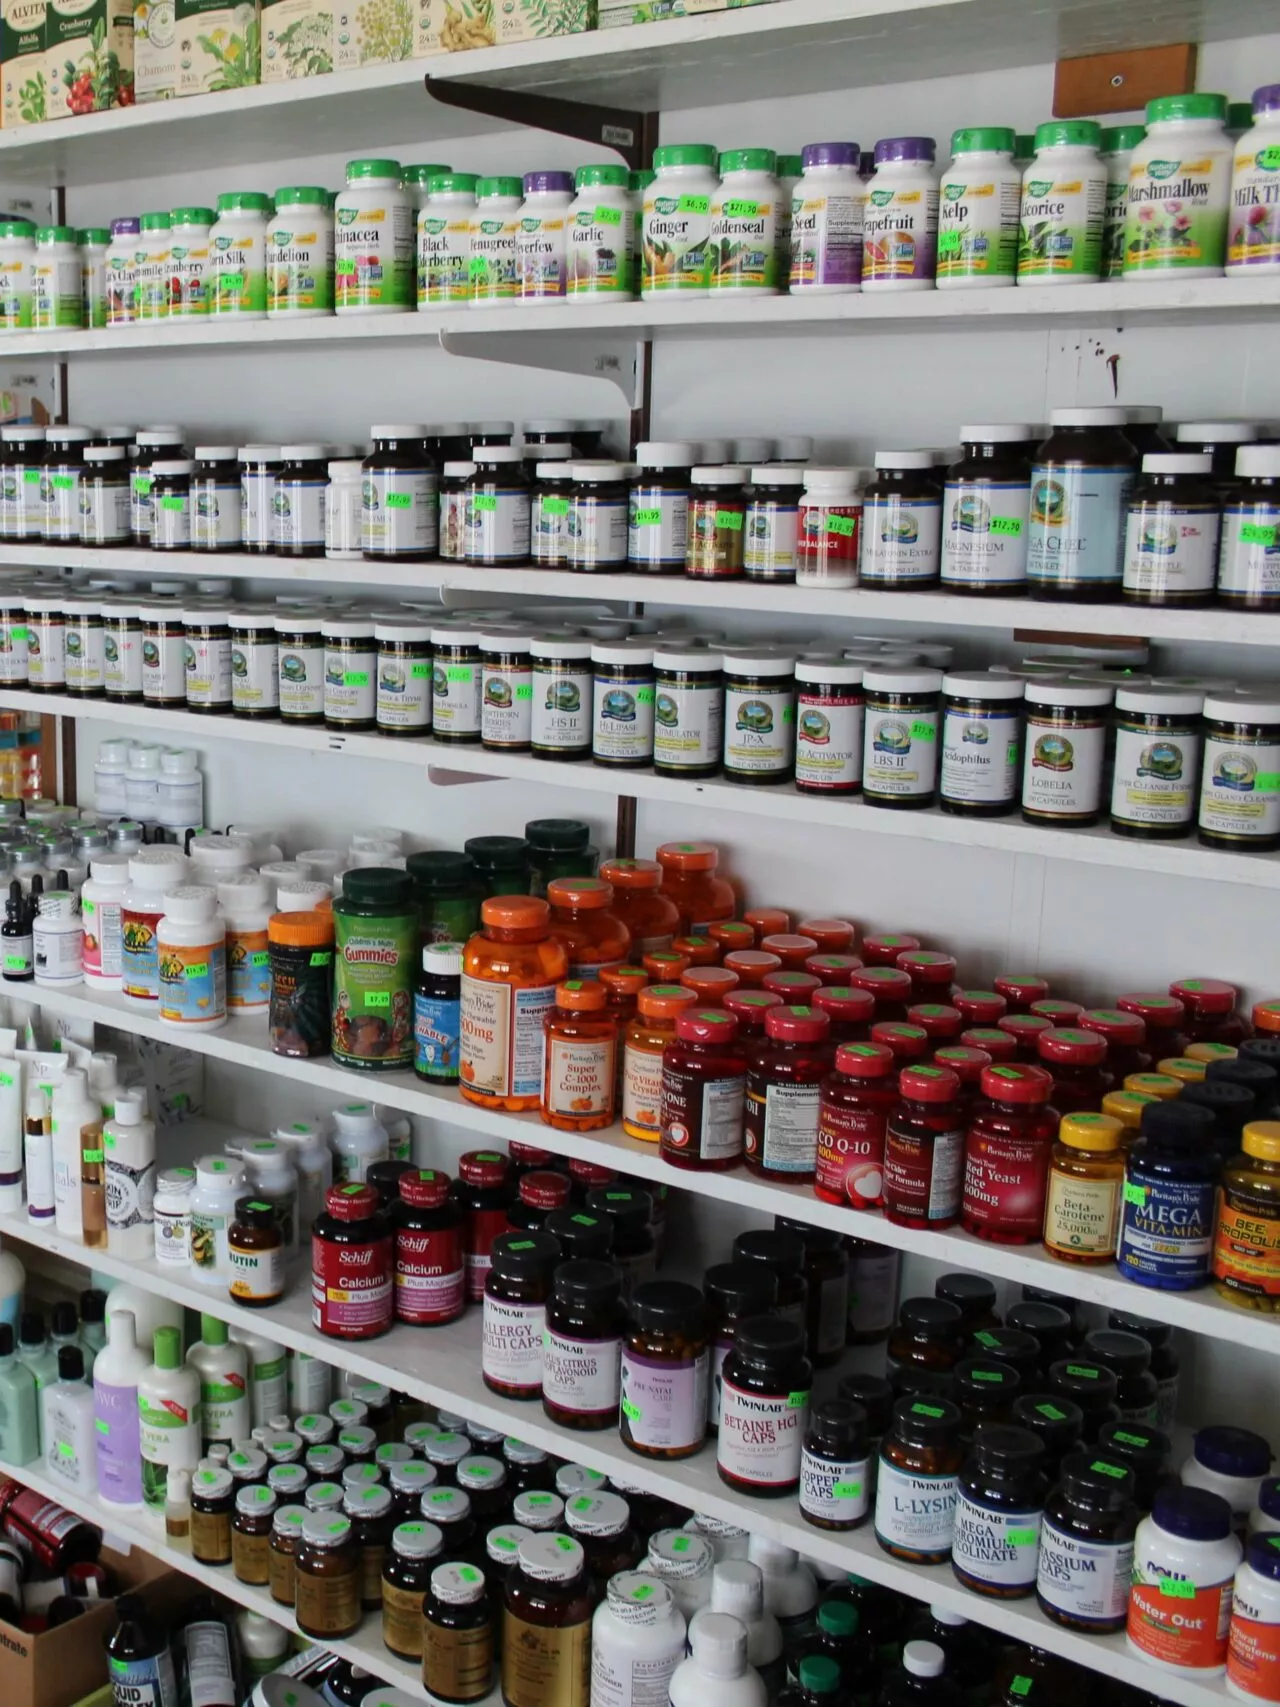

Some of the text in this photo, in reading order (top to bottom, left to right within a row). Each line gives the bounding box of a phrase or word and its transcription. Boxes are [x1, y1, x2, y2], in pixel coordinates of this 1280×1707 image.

[12, 3, 46, 19] ALVITA
[59, 18, 93, 32] Cranberry
[1128, 179, 1211, 203] Marshmallow
[1234, 185, 1259, 206] Milk
[686, 200, 708, 211] $6.50
[729, 202, 757, 214] $21.50
[942, 201, 968, 222] Kelp
[649, 219, 689, 237] Ginger
[710, 218, 765, 236] Goldenseal
[794, 213, 816, 230] Seed
[335, 227, 379, 243] hinacea
[572, 228, 604, 243] Garlic
[422, 237, 449, 252] Black
[226, 250, 245, 265] Silk
[945, 539, 1004, 552] MAGNESIUM
[807, 750, 854, 760] ACTIVATOR
[943, 751, 991, 766] Acidophilus
[1032, 776, 1073, 791] LOBELIA
[344, 945, 398, 965] Gummies
[32, 1060, 48, 1076] Np
[567, 1064, 596, 1075] Super
[565, 1074, 598, 1084] C-1000
[559, 1083, 602, 1095] Complex
[818, 1131, 870, 1155] CO Q-10
[895, 1172, 925, 1188] Formula
[966, 1162, 1021, 1185] Red Yeast
[966, 1172, 986, 1190] Rice
[964, 1184, 999, 1207] 600mg
[1064, 1199, 1094, 1210] Beta-
[1054, 1206, 1105, 1222] Carotene
[1135, 1203, 1202, 1224] MEGA
[1135, 1216, 1203, 1237] VITA-MIN
[1235, 1218, 1266, 1234] BEE
[397, 1235, 430, 1253] Schiff
[228, 1251, 259, 1268] RUTIN
[339, 1249, 374, 1265] Schiff
[397, 1260, 442, 1275] Calcium
[339, 1275, 384, 1289] Calcium
[407, 1278, 424, 1287] Plus
[351, 1292, 369, 1301] Plus
[489, 1303, 525, 1319] TWINLAB
[483, 1323, 533, 1339] ALLERGY
[510, 1335, 543, 1350] CAPS
[549, 1336, 585, 1355] TWINLAB
[544, 1363, 598, 1378] OFLAVONOID
[571, 1357, 598, 1370] CITRUS
[554, 1374, 577, 1386] CAPS
[735, 1395, 783, 1413] TWINLAB
[723, 1412, 774, 1433] BETAINE
[145, 1431, 170, 1443] VERA
[741, 1429, 777, 1444] CAPS
[803, 1455, 845, 1475] TWINLAB
[804, 1481, 835, 1499] CAPS
[911, 1479, 954, 1491] TWINLAB
[893, 1496, 958, 1515] L-LYSIN
[961, 1500, 1004, 1525] TWINLAB
[960, 1517, 995, 1537] MEGA
[1039, 1544, 1098, 1573] TASSIUM
[1041, 1560, 1072, 1581] CAPS
[1132, 1589, 1203, 1631] Water Out
